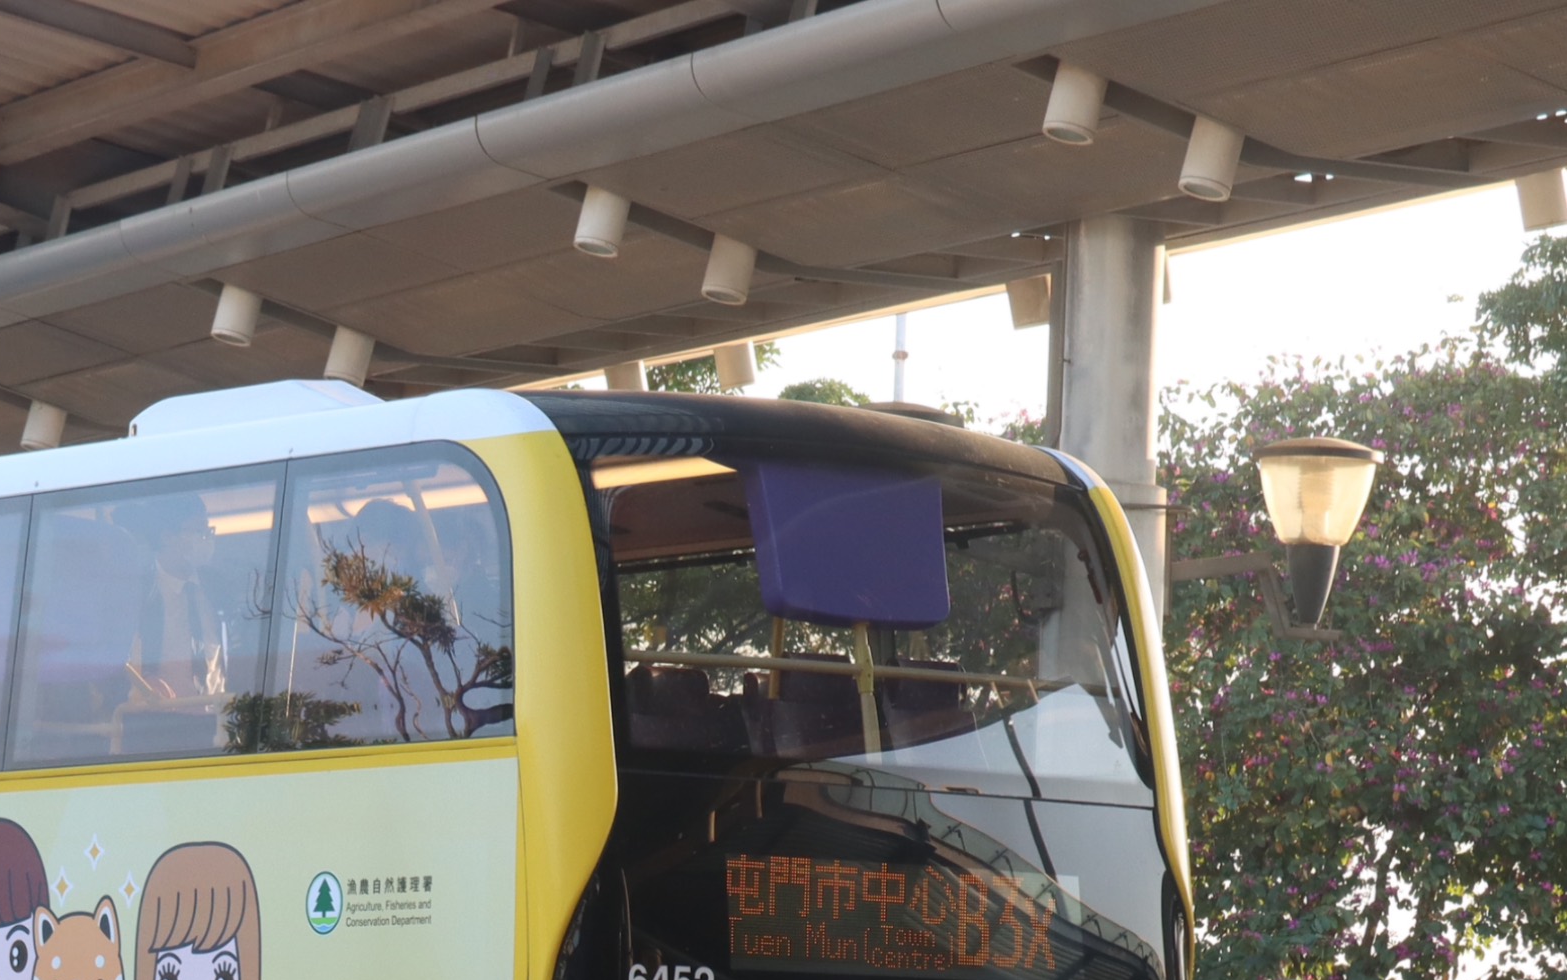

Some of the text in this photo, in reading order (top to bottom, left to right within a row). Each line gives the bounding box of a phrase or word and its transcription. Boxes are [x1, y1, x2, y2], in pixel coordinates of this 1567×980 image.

[346, 875, 433, 895] 漁農自然護理署
[726, 854, 957, 925] 屯門市中心
[345, 915, 432, 928] Conservation Department
[346, 899, 432, 915] Agriculture, Fisheries and
[958, 874, 1057, 970] B3X
[729, 917, 791, 957] Tuen
[806, 921, 858, 960] Mun
